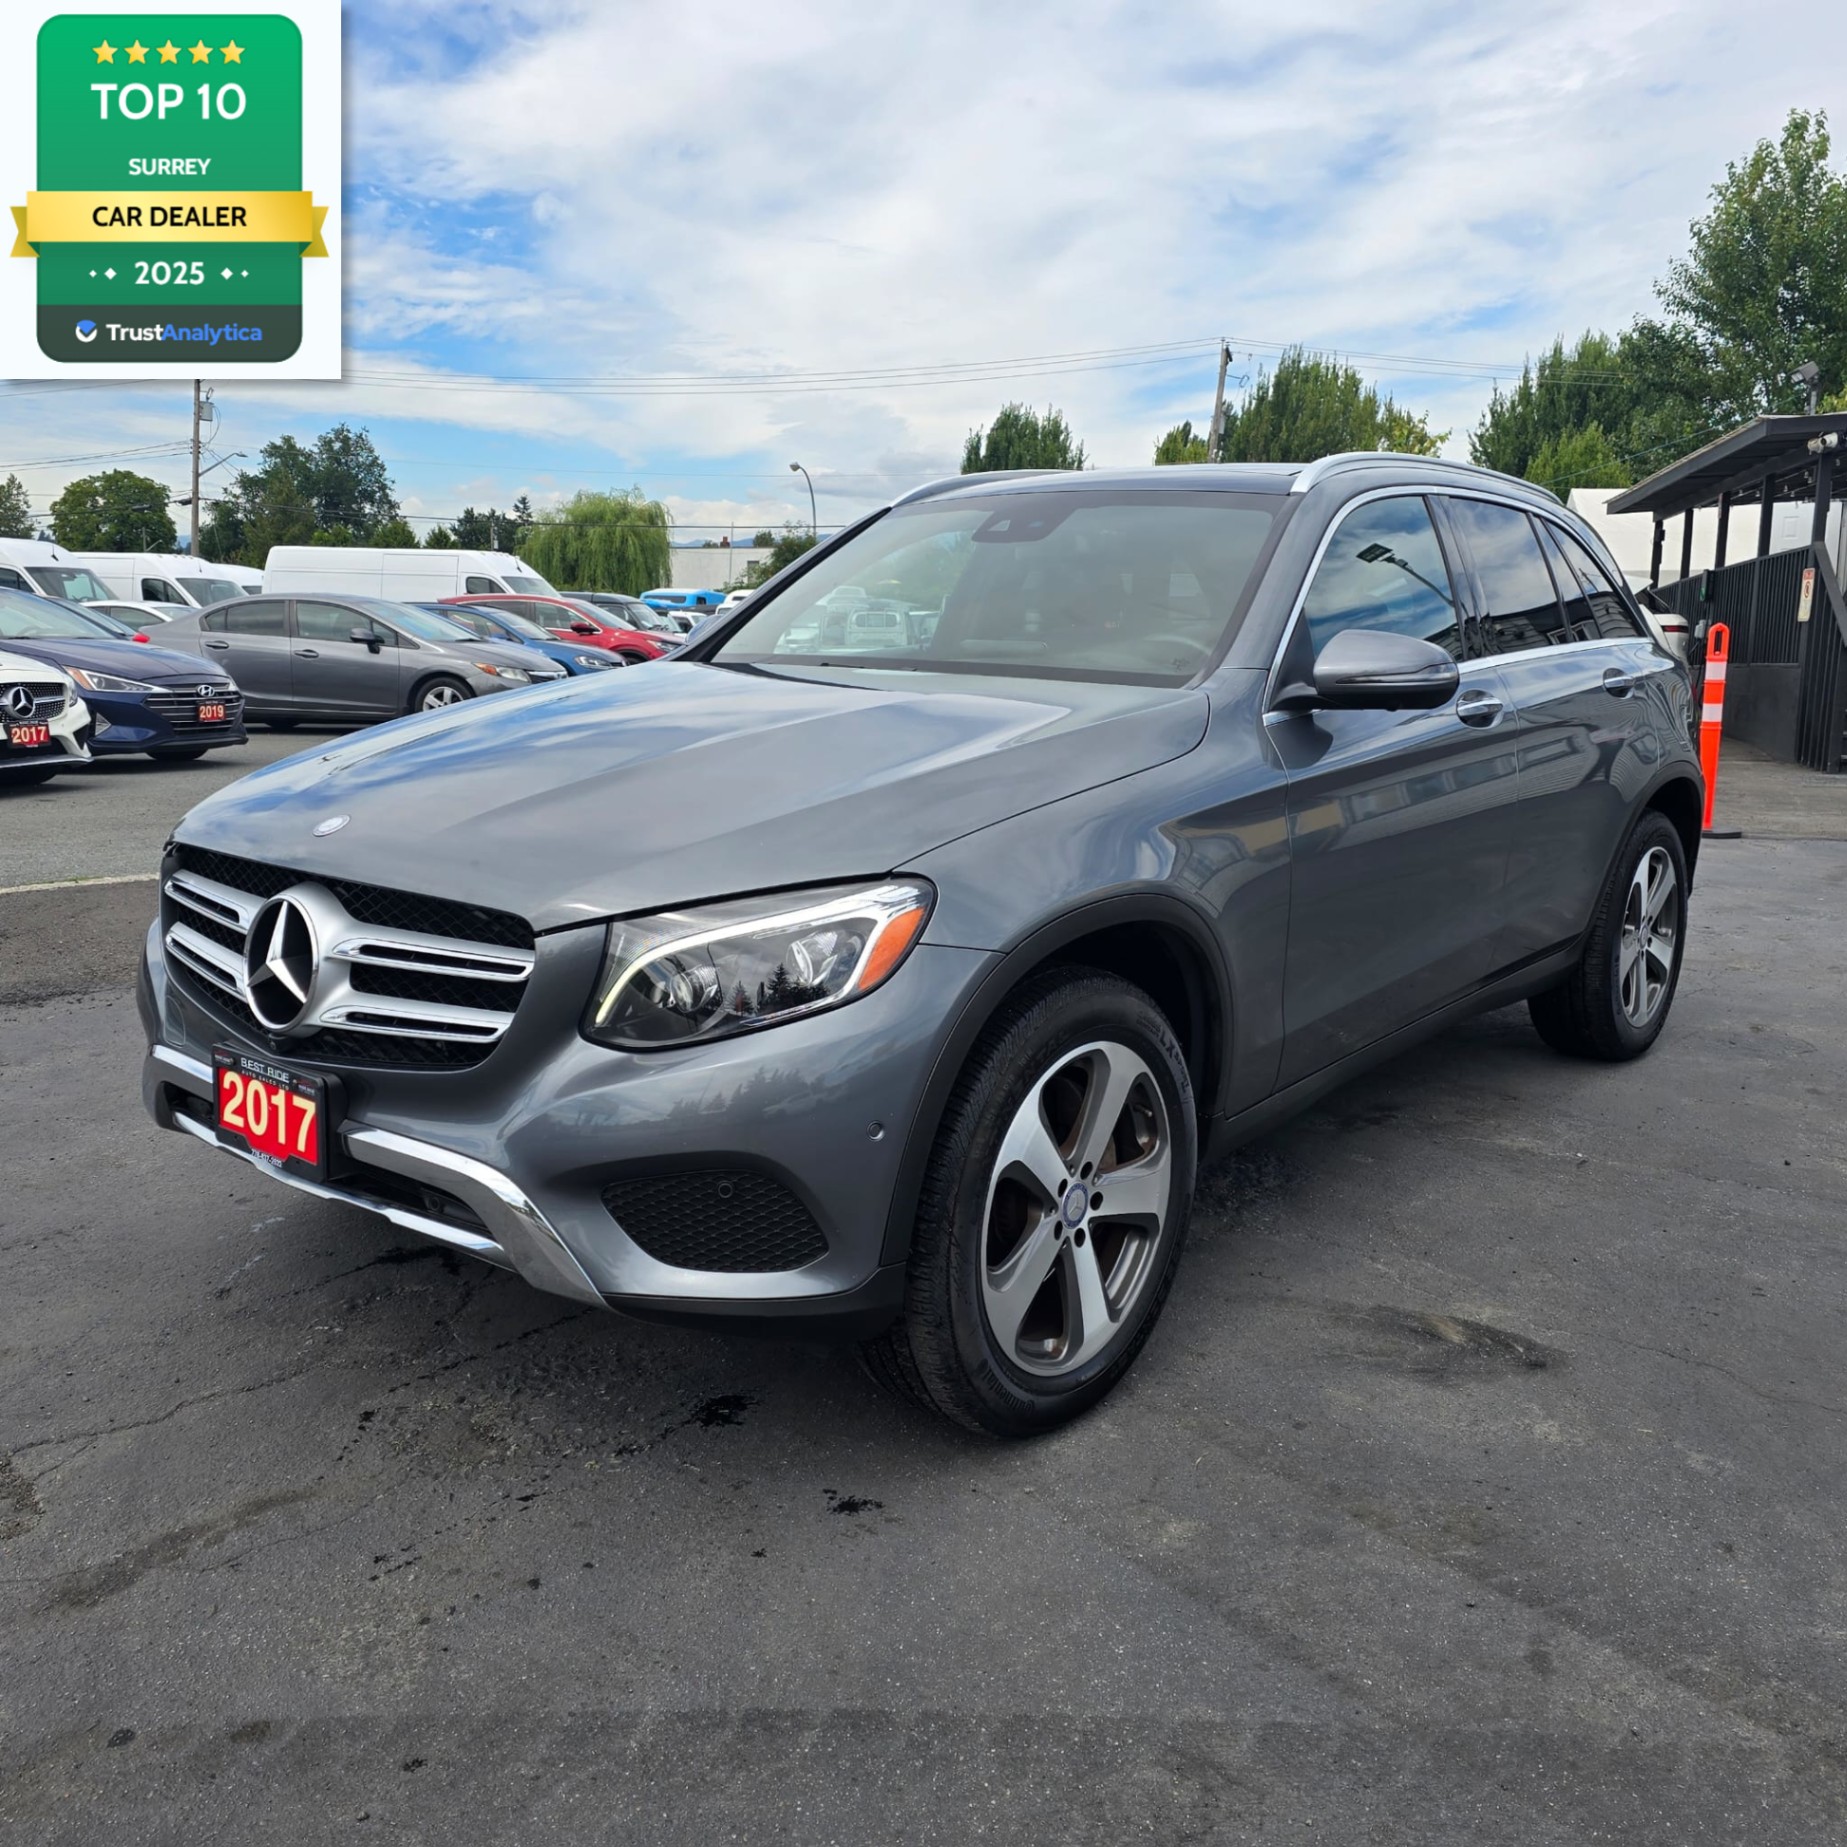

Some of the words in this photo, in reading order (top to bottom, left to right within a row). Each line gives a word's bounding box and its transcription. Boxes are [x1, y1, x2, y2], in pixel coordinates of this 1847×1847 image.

[199, 705, 224, 718] 2019
[11, 726, 47, 744] 2017
[240, 1057, 265, 1074] BEST
[267, 1067, 289, 1083] RIDE
[223, 1071, 316, 1153] 2017
